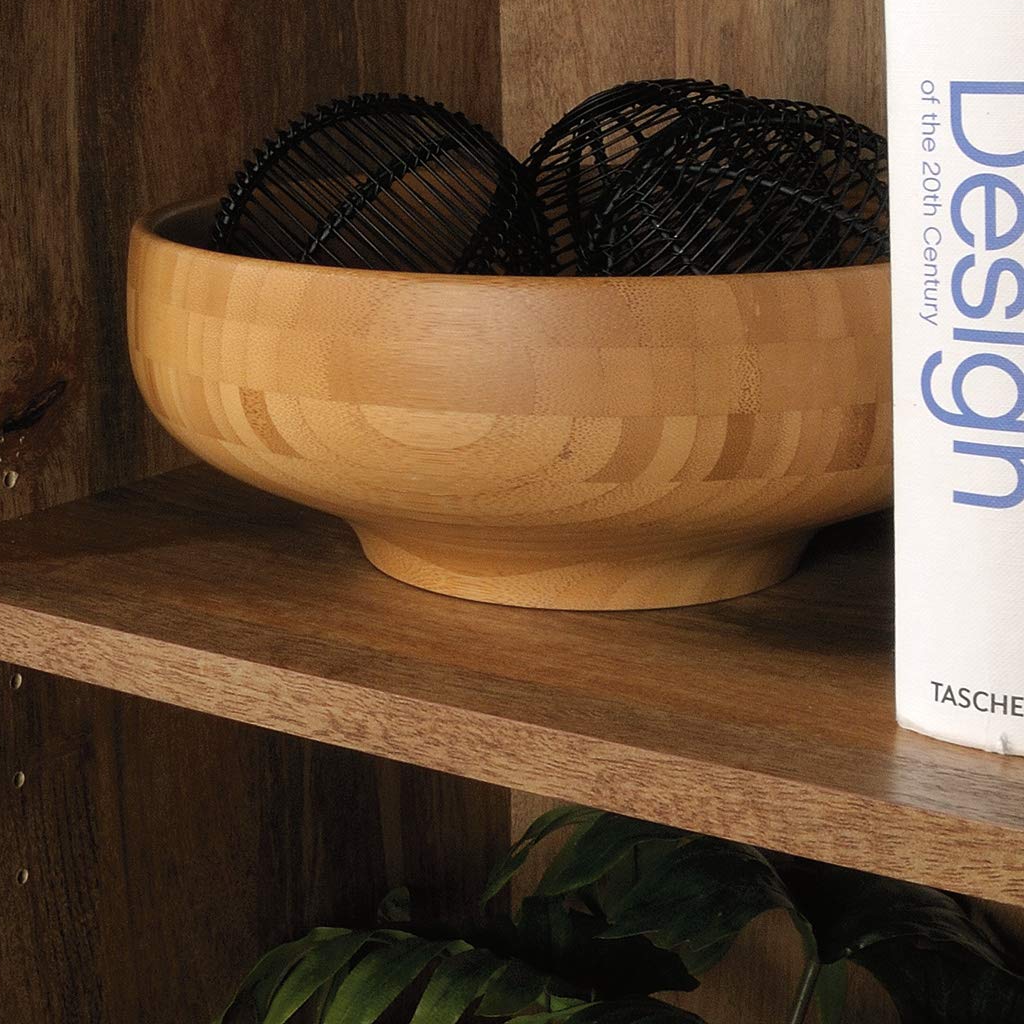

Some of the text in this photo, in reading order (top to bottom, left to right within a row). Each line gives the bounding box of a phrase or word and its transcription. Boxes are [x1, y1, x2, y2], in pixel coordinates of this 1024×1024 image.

[919, 80, 943, 326] of the 20th Century
[921, 81, 1024, 510] Design
[931, 680, 1024, 717] TASCHE
